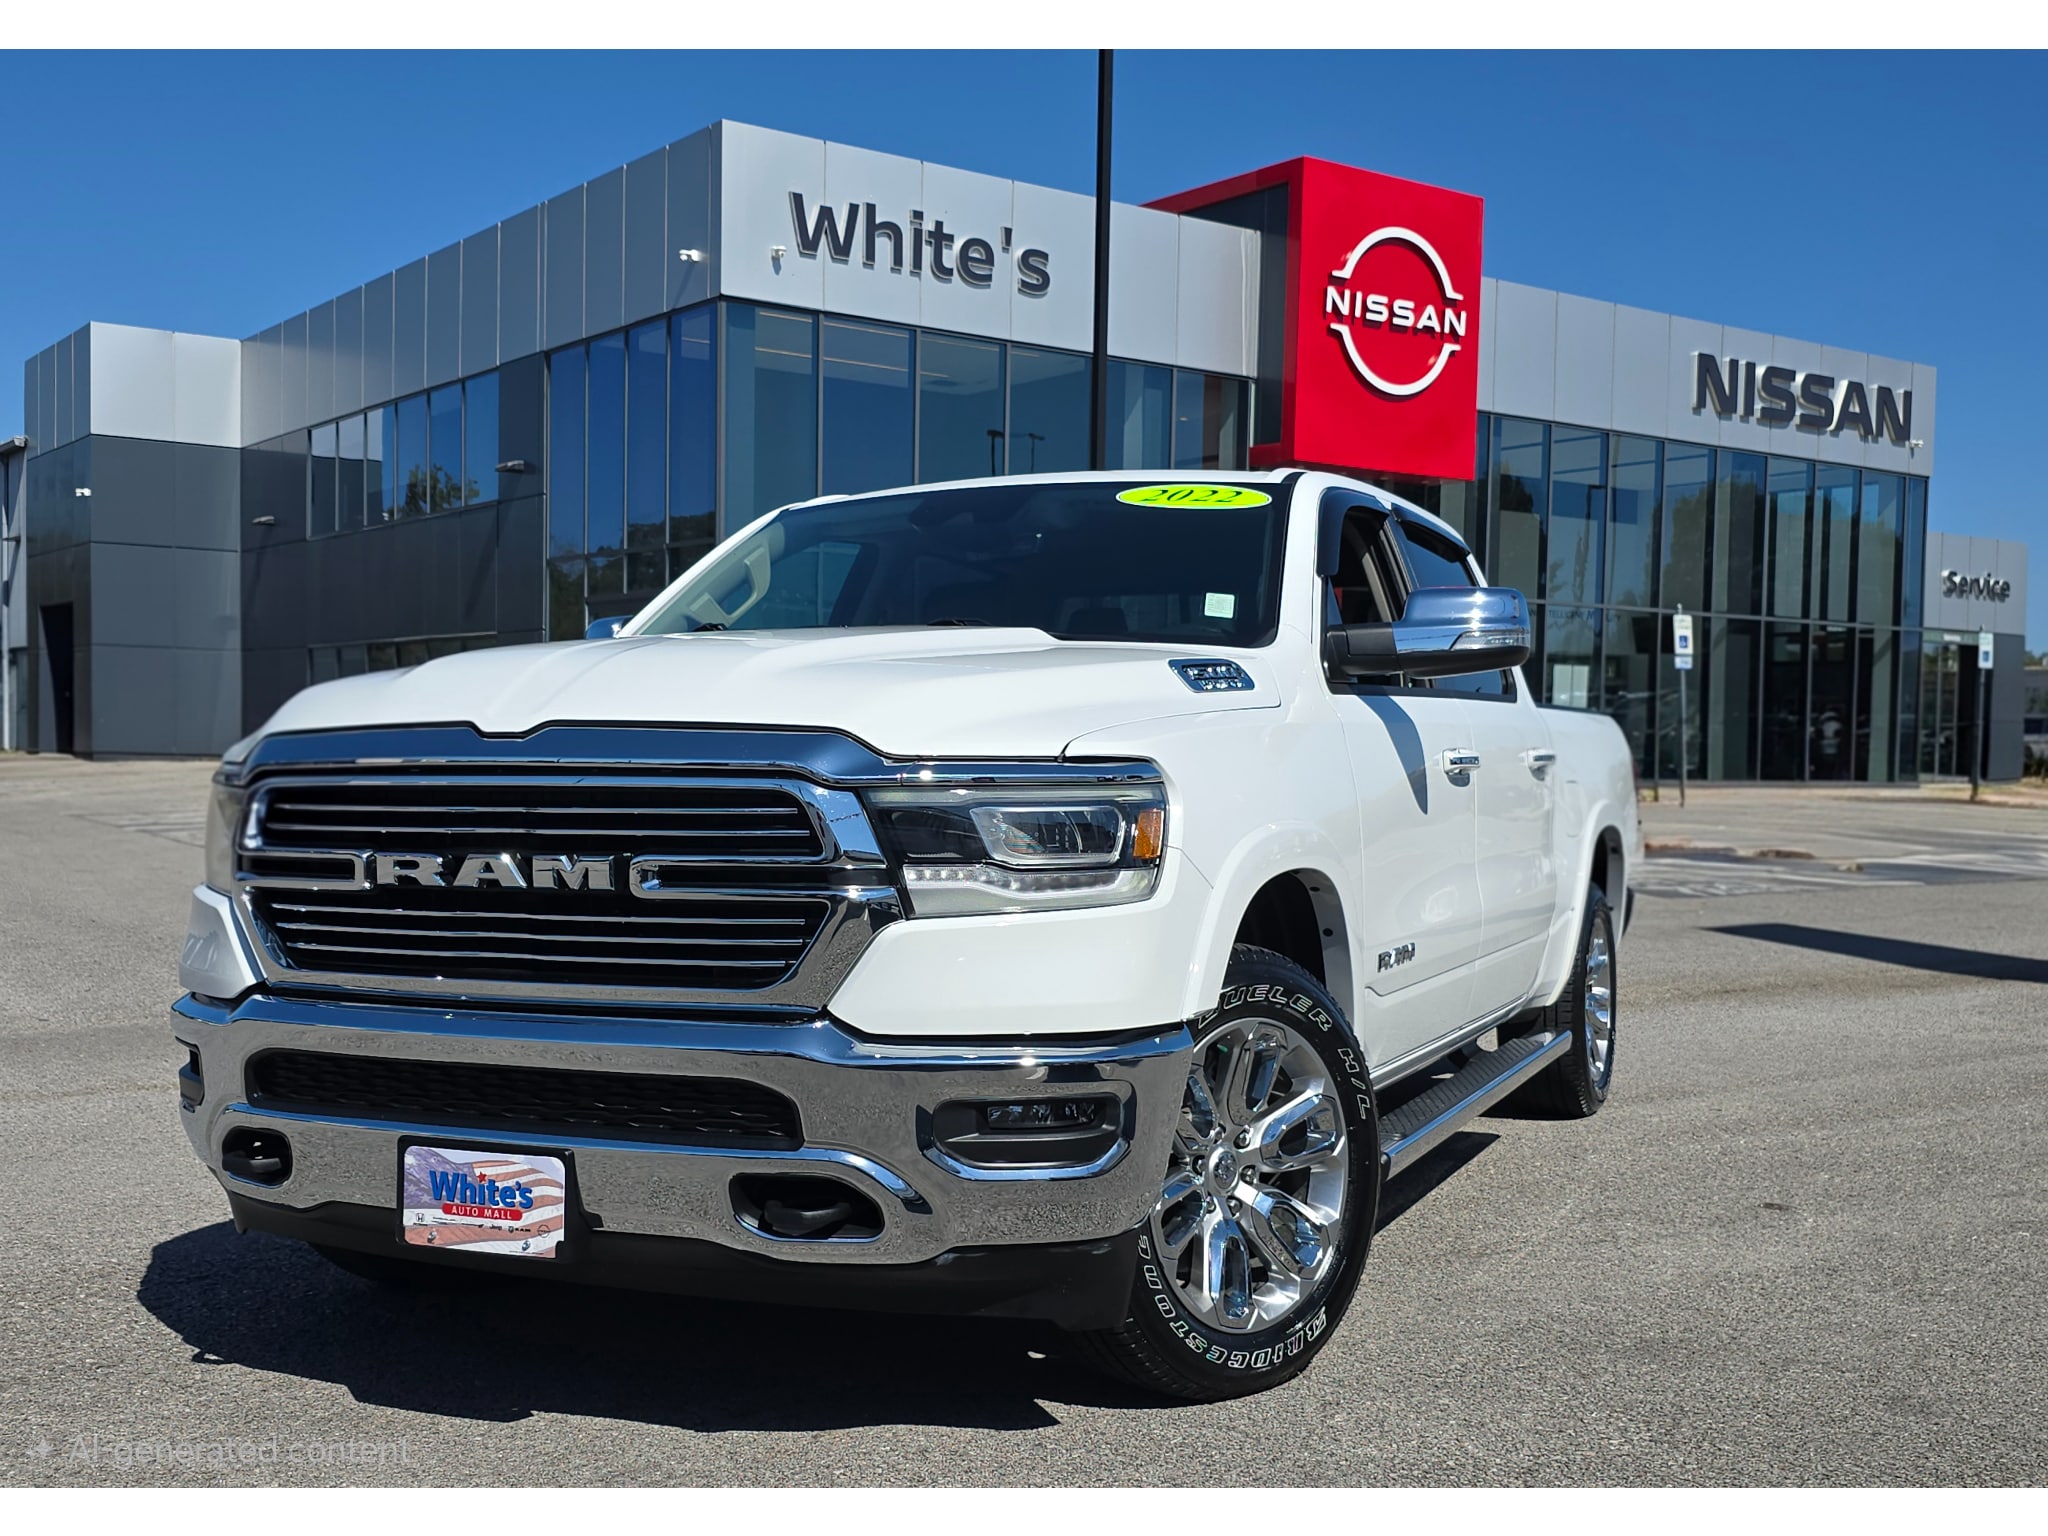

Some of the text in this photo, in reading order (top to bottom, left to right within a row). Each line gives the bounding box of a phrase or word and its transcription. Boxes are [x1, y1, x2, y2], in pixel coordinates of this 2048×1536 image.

[788, 191, 1051, 297] White's
[1325, 285, 1467, 337] NISSAN
[1692, 352, 1913, 442] NISSAN
[1139, 489, 1243, 503] 2022
[1942, 571, 2011, 603] Service
[376, 852, 615, 891] RAM
[429, 1170, 534, 1210] White's
[451, 1205, 512, 1219] AUTO MALL
